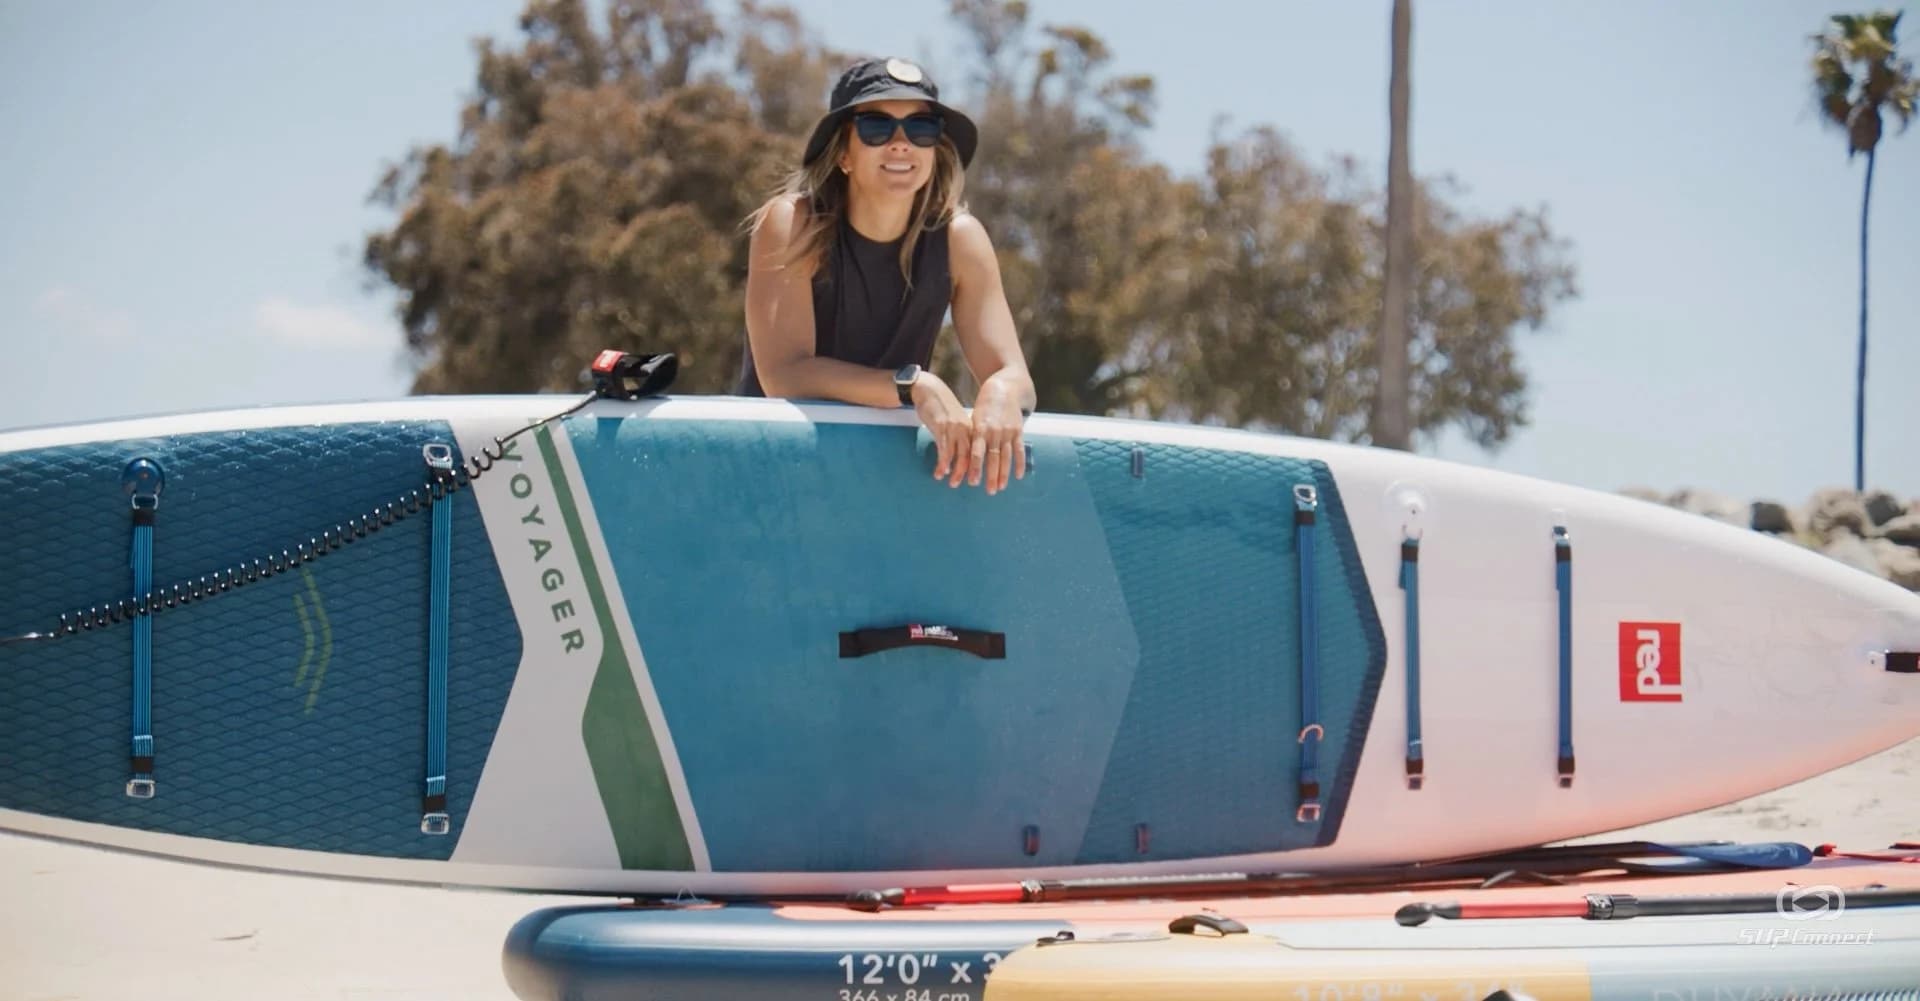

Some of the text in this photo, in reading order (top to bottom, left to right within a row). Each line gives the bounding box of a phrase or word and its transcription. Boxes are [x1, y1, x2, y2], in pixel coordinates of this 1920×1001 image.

[502, 440, 585, 654] VOYAGER
[1636, 629, 1683, 695] red
[838, 953, 938, 985] 12'0"
[950, 961, 973, 984] x
